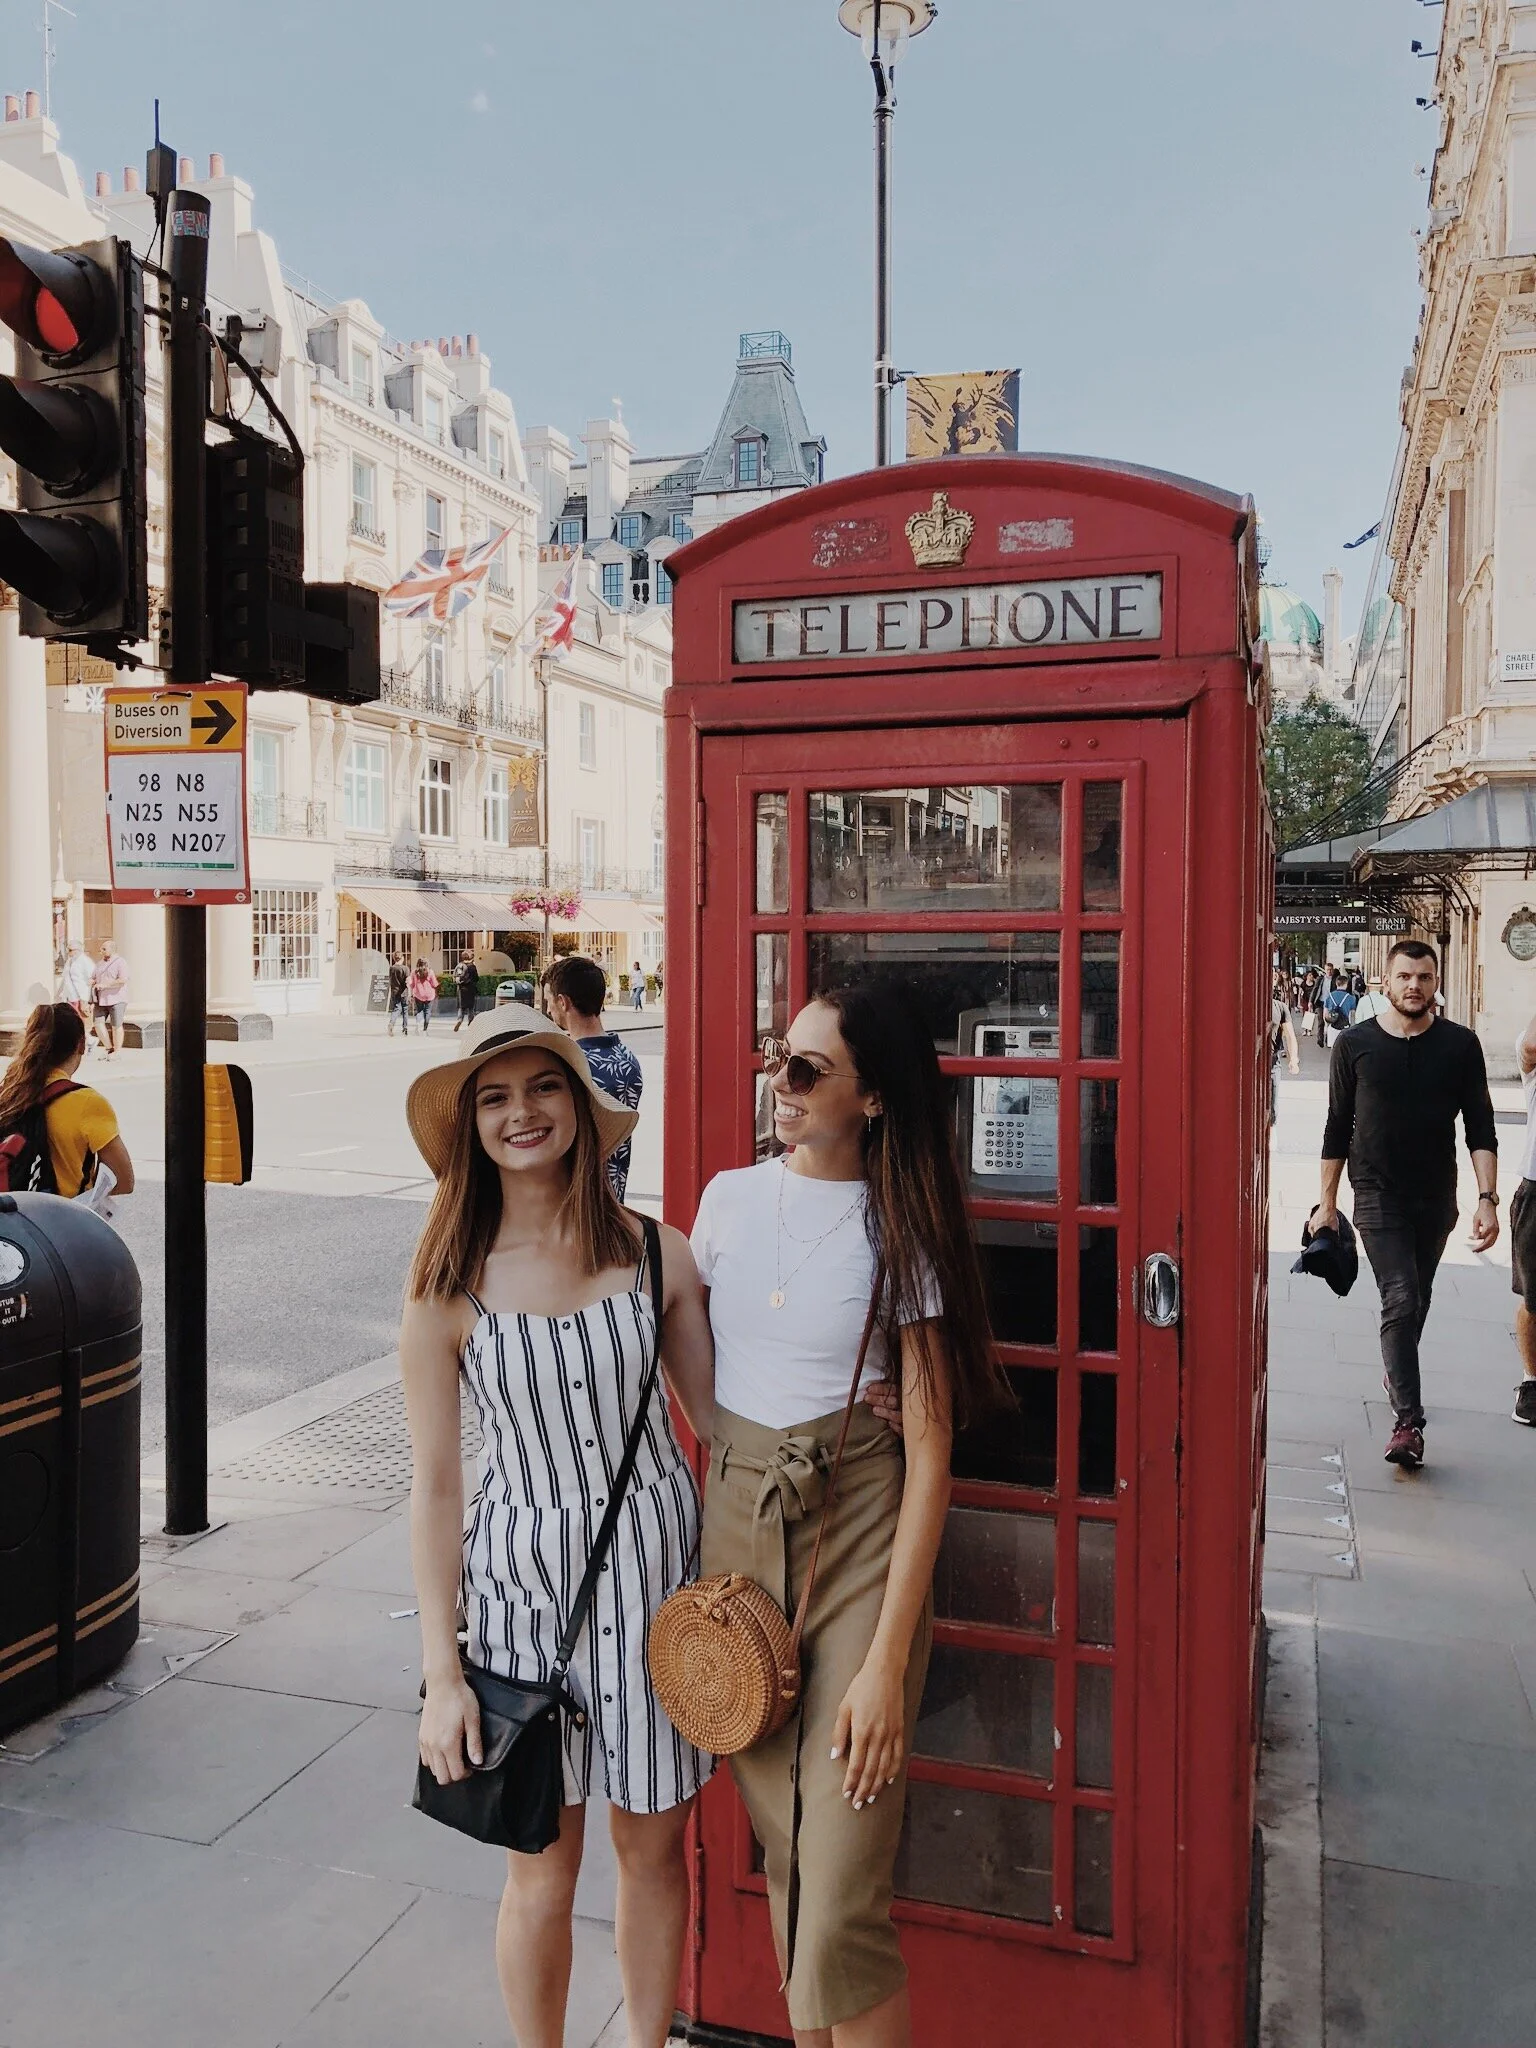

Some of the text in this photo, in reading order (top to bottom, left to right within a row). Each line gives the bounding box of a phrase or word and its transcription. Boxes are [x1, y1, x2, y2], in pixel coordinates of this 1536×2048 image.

[750, 584, 1145, 657] TELEPHONE
[1505, 663, 1534, 671] STREET
[115, 703, 179, 718] Buses on
[115, 723, 182, 739] Diversion
[138, 773, 205, 792] 98 N8
[126, 803, 218, 822] N25 N55
[120, 832, 226, 852] N98 N207
[1322, 916, 1366, 924] THEATRE
[1376, 917, 1406, 925] GRAND
[2, 1315, 17, 1325] OUT!
